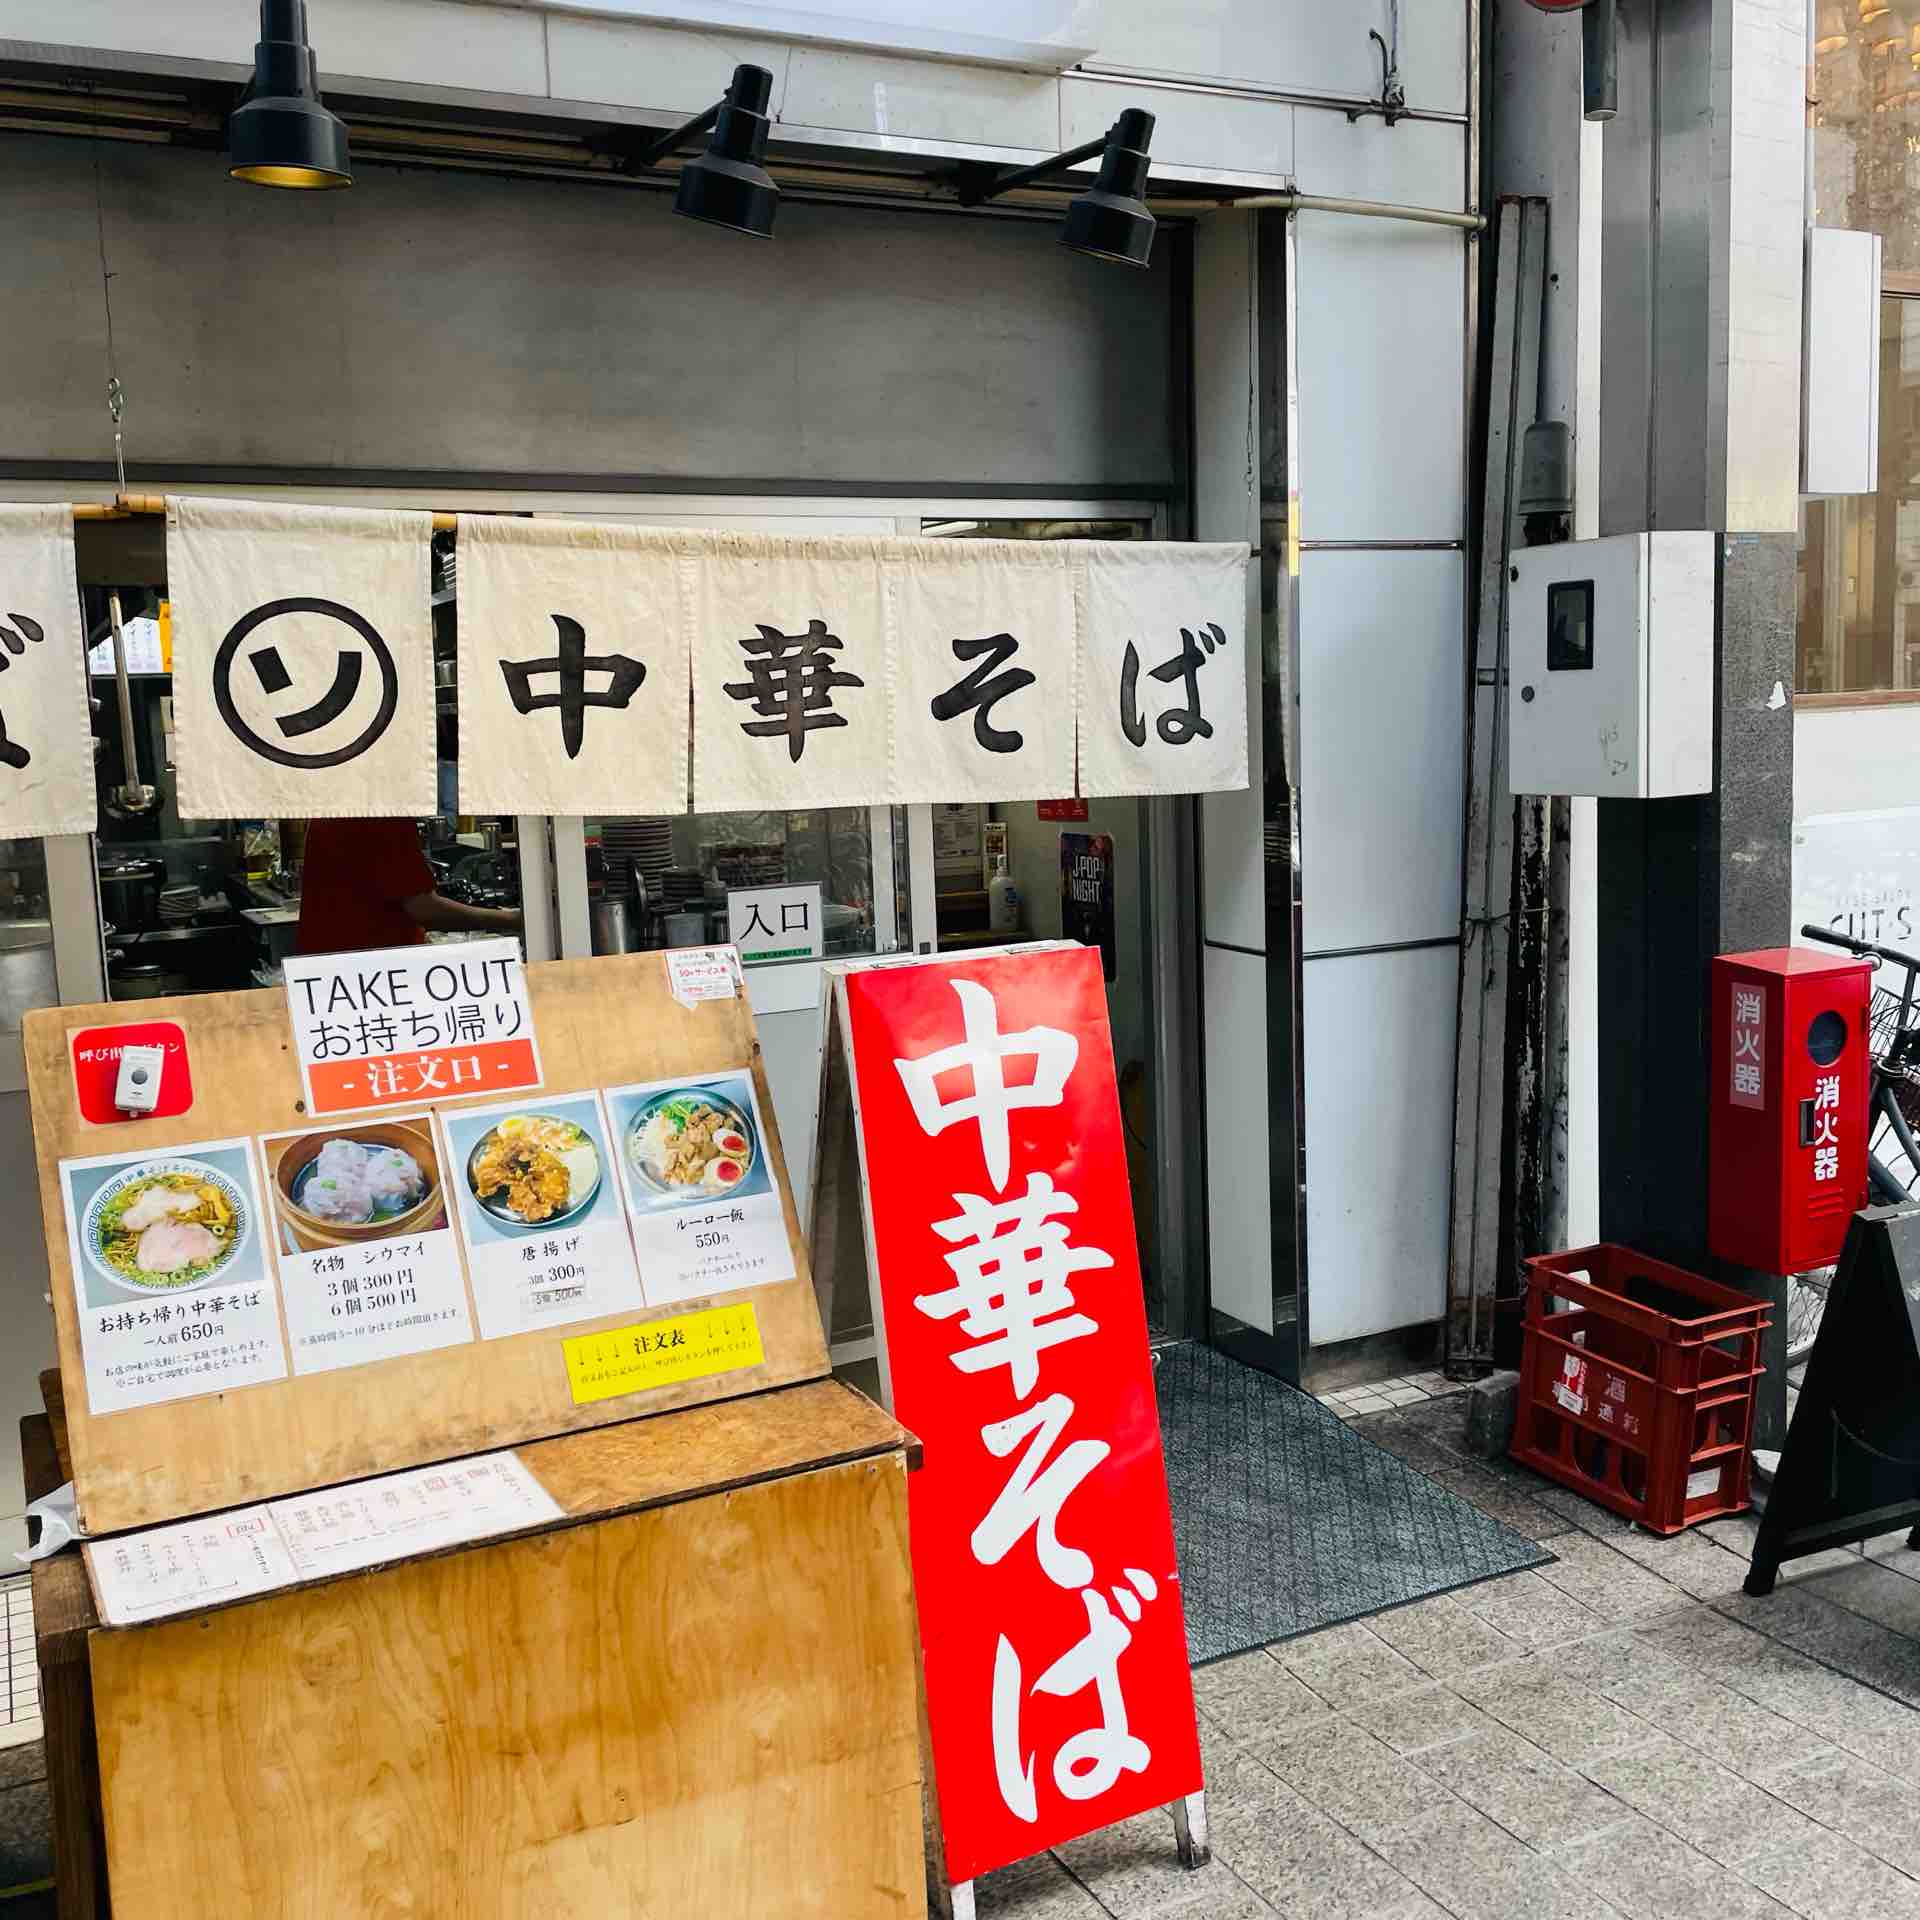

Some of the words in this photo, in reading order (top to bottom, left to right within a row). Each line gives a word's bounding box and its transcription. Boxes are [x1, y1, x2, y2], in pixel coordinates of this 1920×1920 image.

[499, 613, 1227, 764] 中華そば
[1072, 879, 1101, 904] NIGHT
[739, 902, 809, 941] 入口
[294, 968, 413, 1015] TAKE
[424, 958, 516, 1001] OUT
[309, 1000, 521, 1059] お持ち帰り
[1735, 991, 1761, 1096] 消火器
[1814, 1075, 1840, 1181] 消火器
[675, 1207, 745, 1231] ルーロー飯
[695, 1231, 730, 1248] 550円
[312, 1255, 345, 1275] 名物
[363, 1240, 425, 1265] シウマイ
[522, 1236, 581, 1261] 唐揚げ
[98, 1289, 263, 1334] お持ち帰り中華そば
[633, 1328, 686, 1355] 注文表
[893, 978, 1158, 1823] 中華そば
